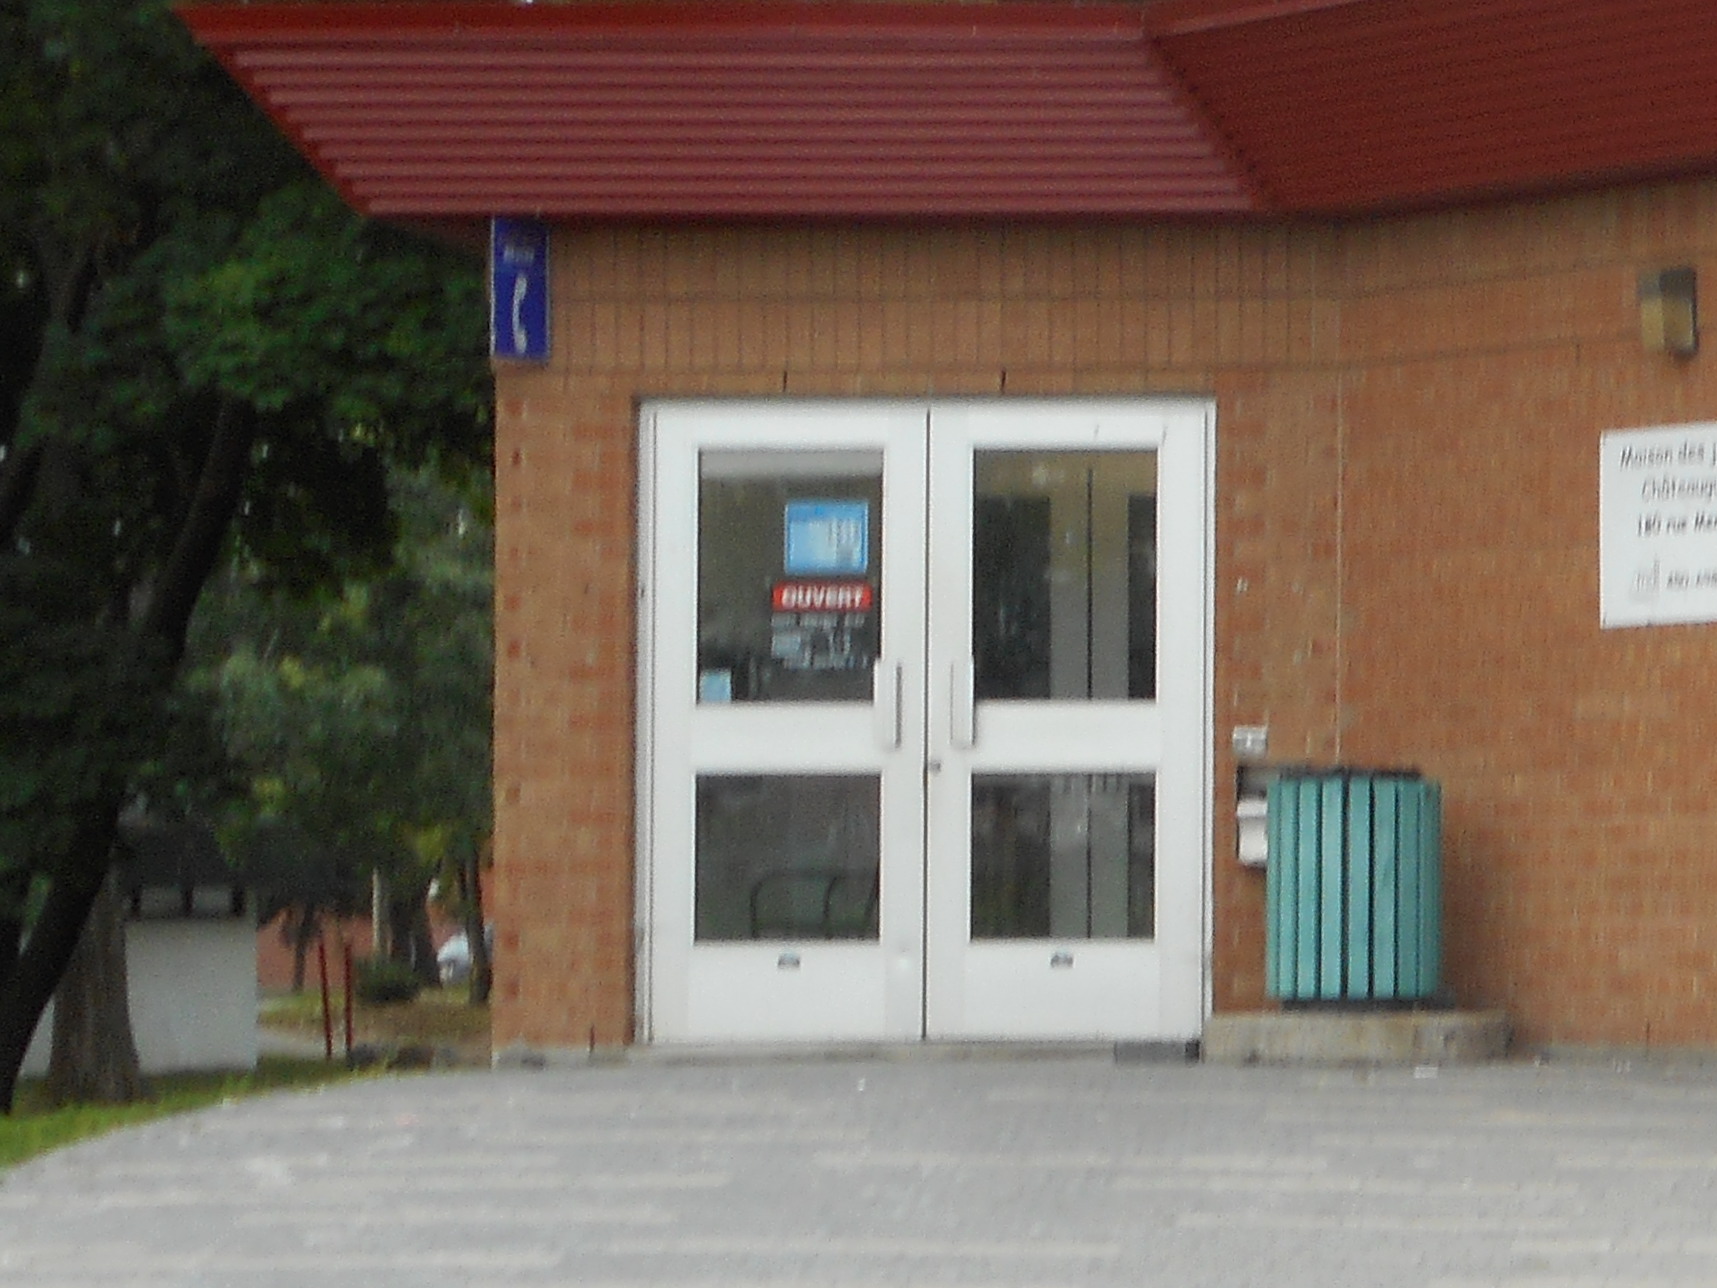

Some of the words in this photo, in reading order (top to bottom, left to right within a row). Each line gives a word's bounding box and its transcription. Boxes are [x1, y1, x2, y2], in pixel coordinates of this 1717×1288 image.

[1620, 444, 1673, 470] Maison
[1678, 440, 1704, 464] des
[1666, 517, 1687, 534] rue
[781, 585, 864, 609] OUVERT
